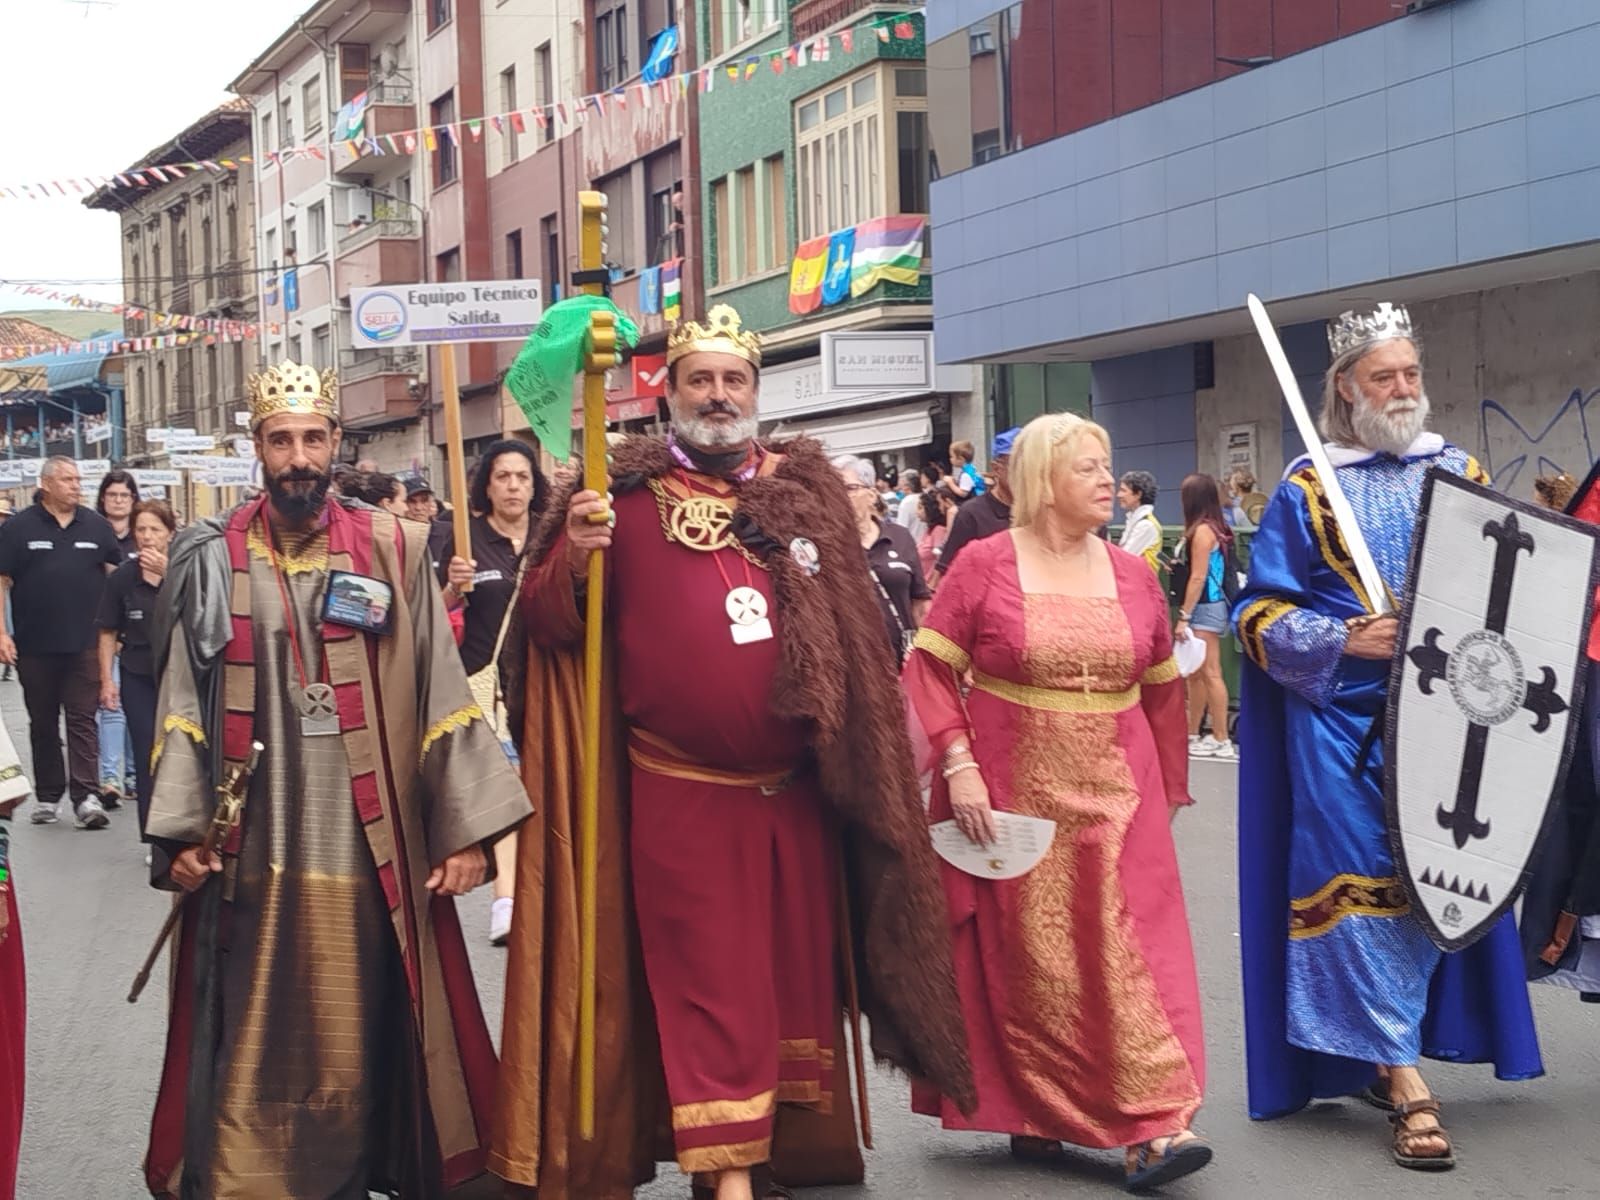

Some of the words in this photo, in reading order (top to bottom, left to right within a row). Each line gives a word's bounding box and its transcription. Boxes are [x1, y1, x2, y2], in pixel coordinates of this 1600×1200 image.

[408, 288, 466, 306] Equipo
[472, 284, 538, 302] Técnico
[364, 314, 400, 326] SELLA
[448, 310, 501, 326] Salida
[838, 354, 868, 365] SAN
[871, 354, 924, 365] MIGUEL
